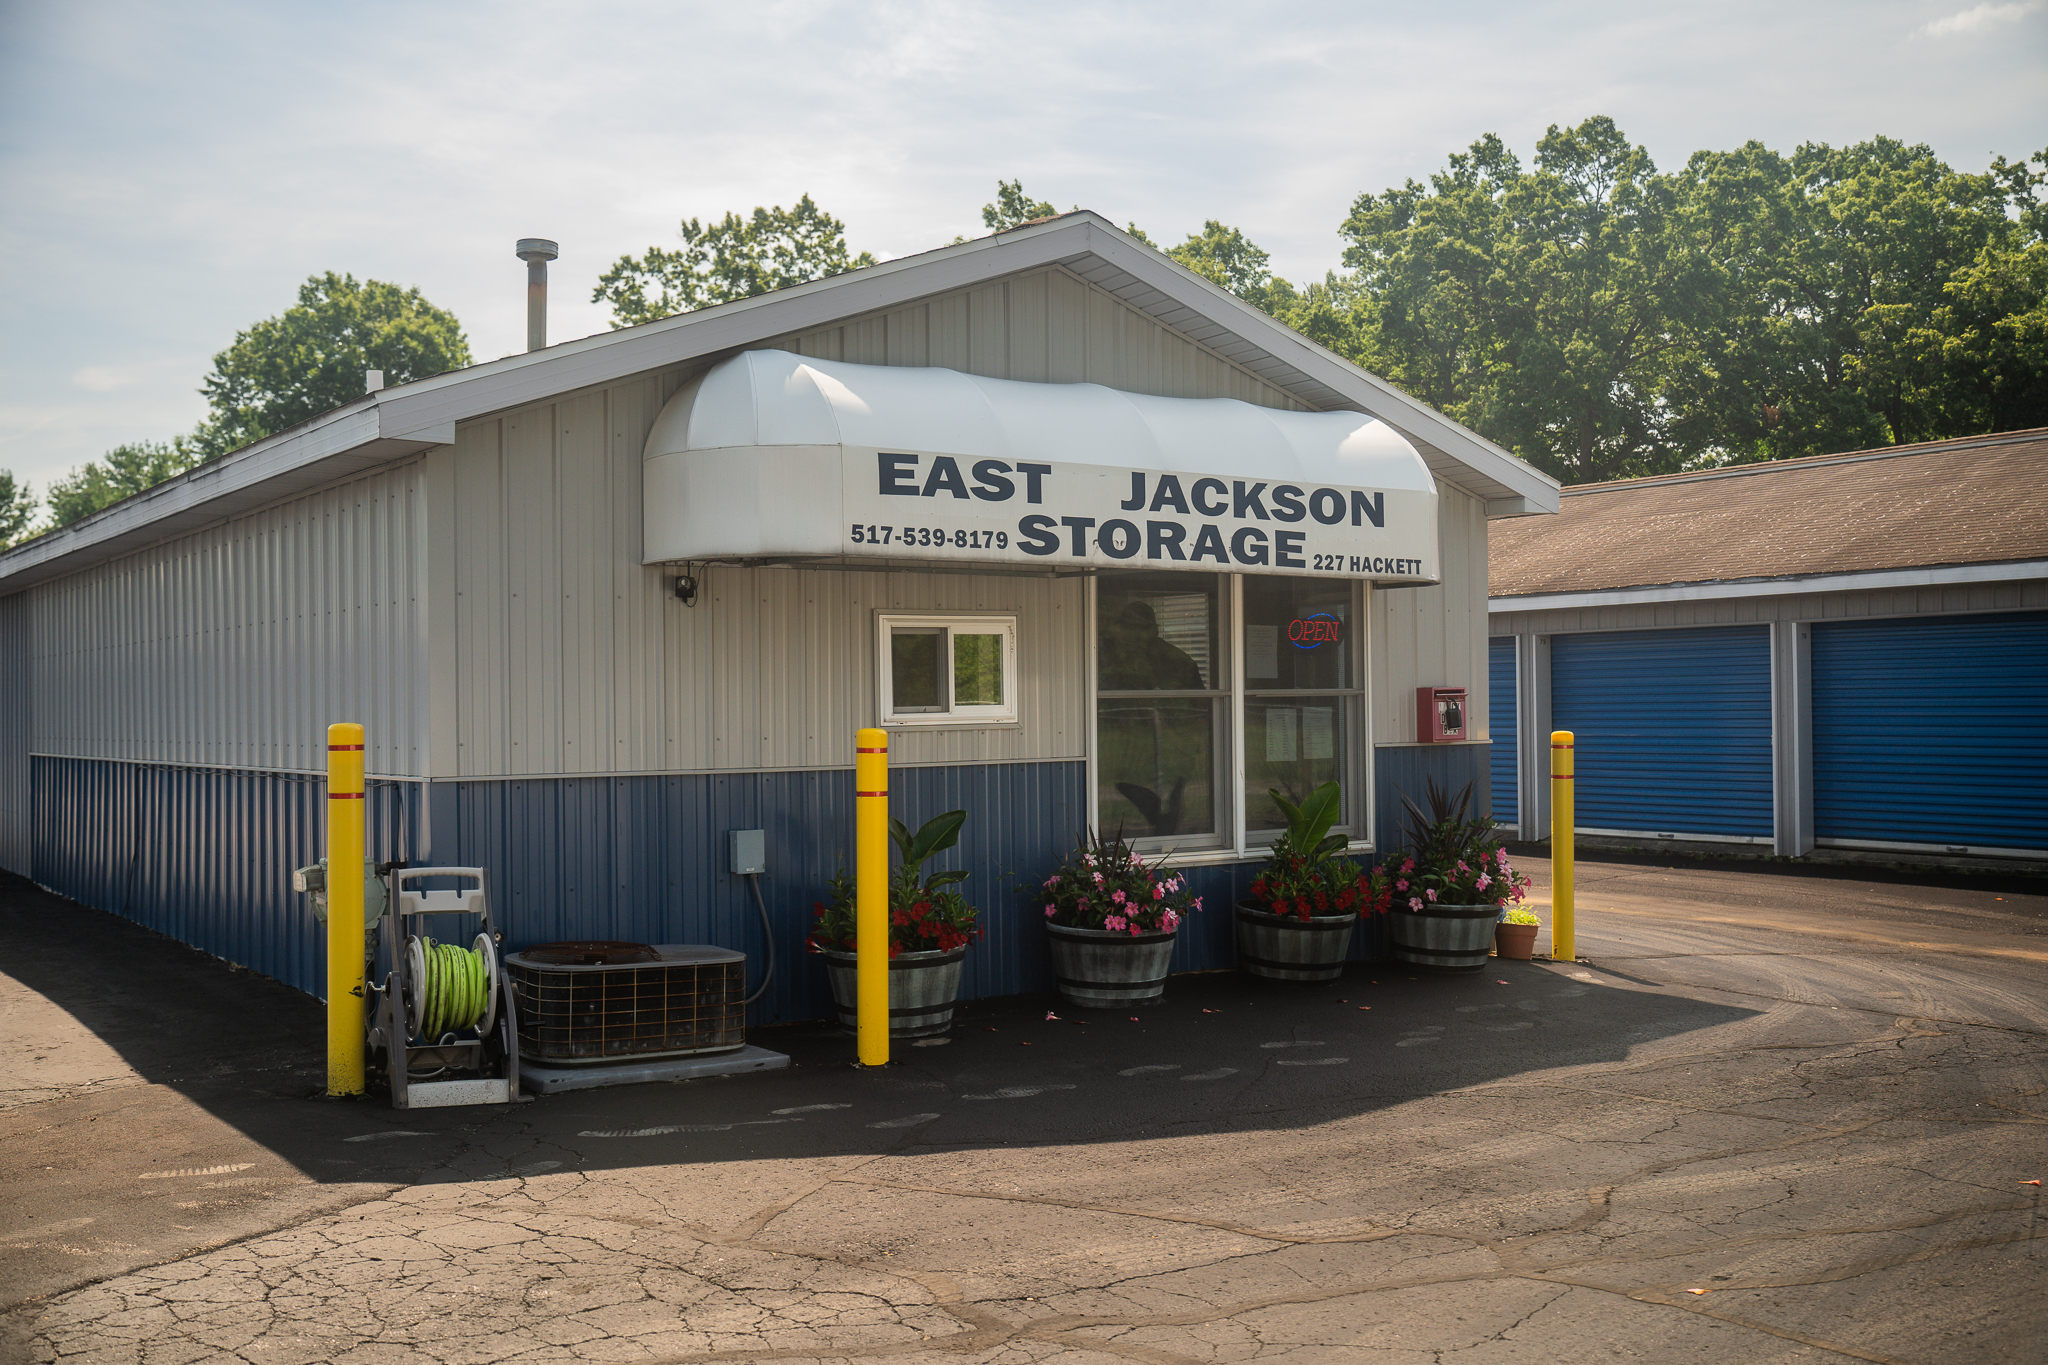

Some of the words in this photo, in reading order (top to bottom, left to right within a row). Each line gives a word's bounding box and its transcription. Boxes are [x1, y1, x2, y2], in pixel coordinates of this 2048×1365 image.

[878, 452, 1052, 504] EAST
[1121, 471, 1385, 528] JACKSON
[850, 523, 1009, 550] 517-539-8179
[1016, 514, 1306, 569] STORAGE
[1313, 553, 1345, 571] 227
[1349, 555, 1422, 575] HACKETT
[1288, 619, 1340, 641] OPEN
